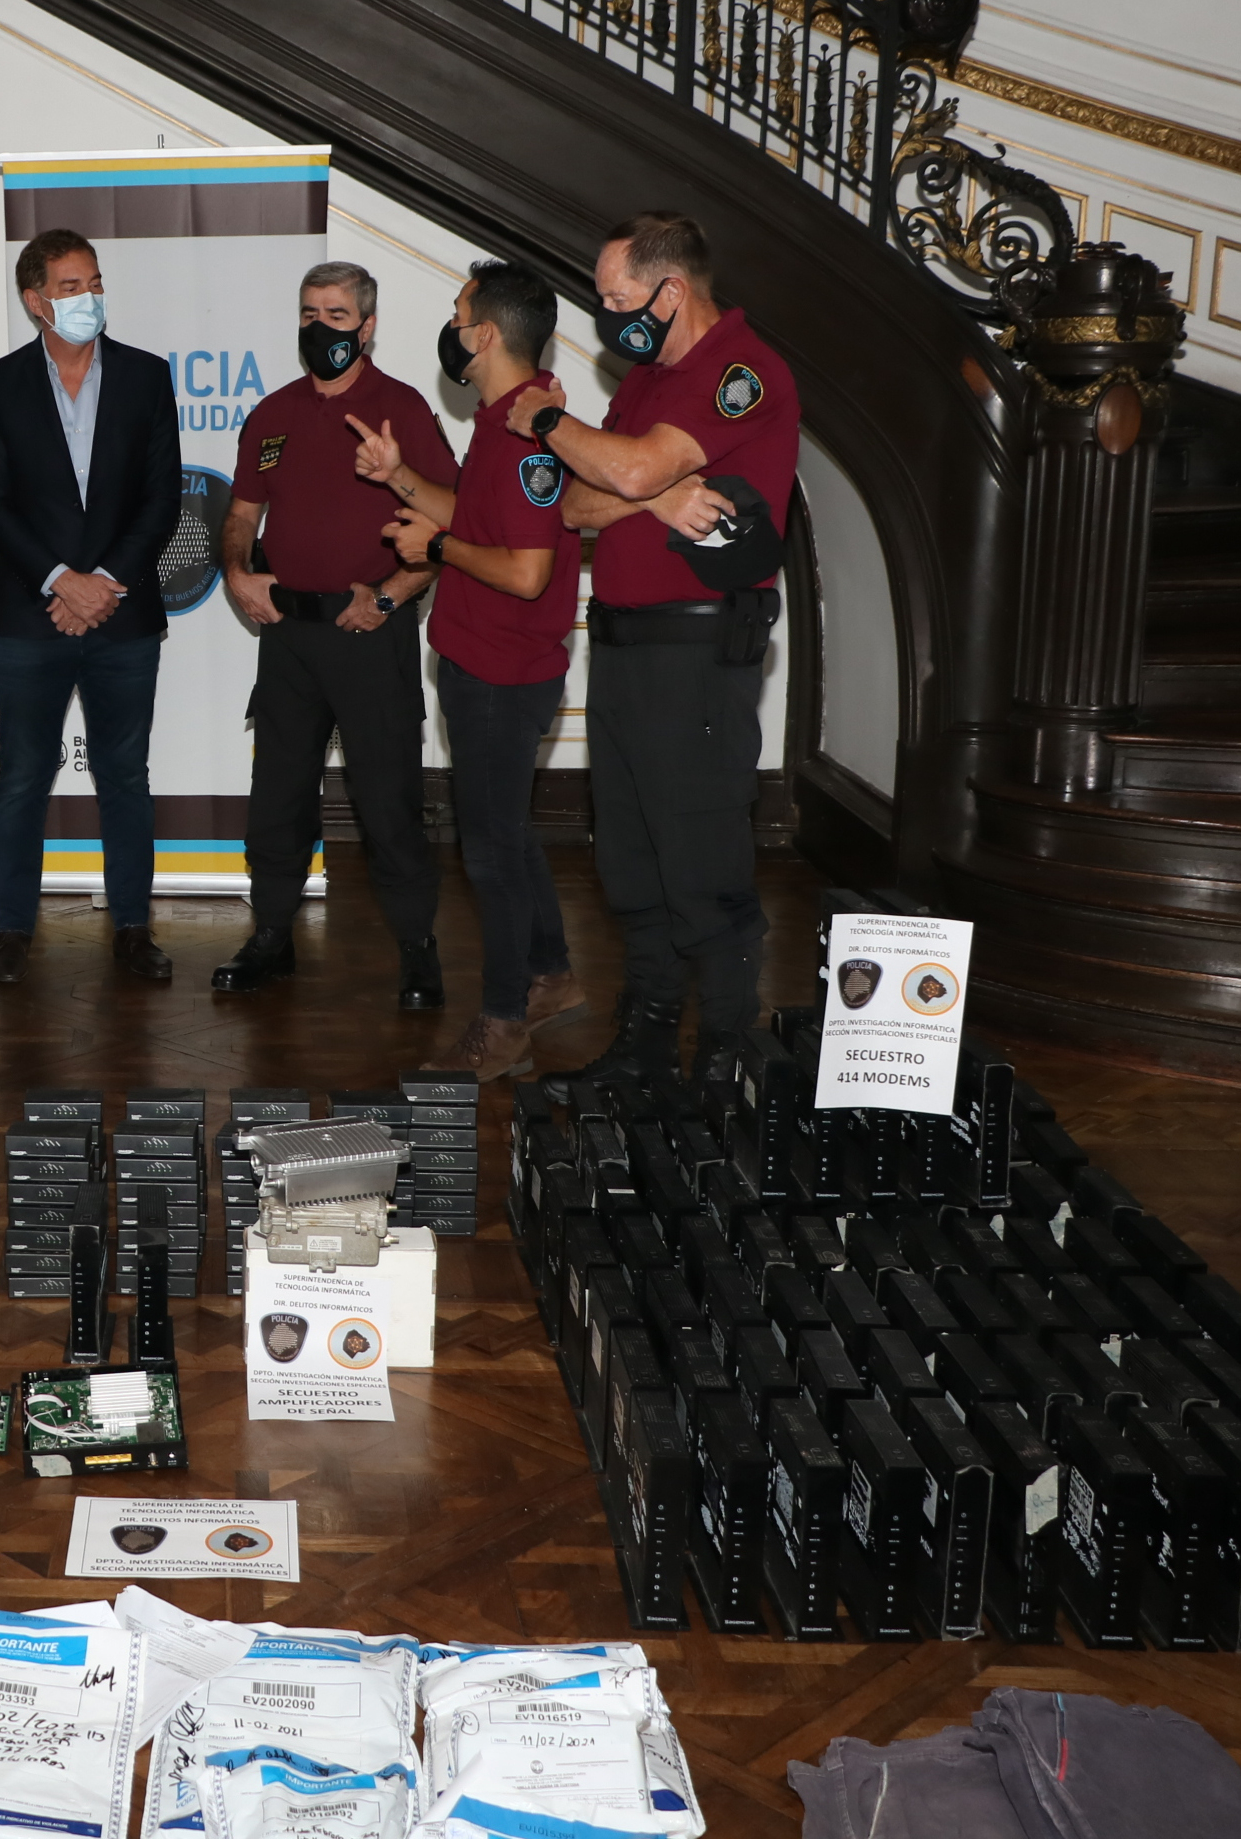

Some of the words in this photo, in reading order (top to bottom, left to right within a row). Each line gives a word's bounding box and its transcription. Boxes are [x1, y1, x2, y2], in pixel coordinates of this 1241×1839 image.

[179, 404, 258, 432] IUDA
[527, 457, 555, 467] POLICIA
[175, 582, 204, 602] BUENOS
[199, 565, 216, 590] AIRES
[857, 918, 929, 929] SUPERINTENDENCIA
[930, 922, 941, 930] DE
[850, 928, 894, 937] TECNOLOGÍA
[895, 930, 948, 940] INFORMÁTICA
[848, 945, 862, 953] DIR.
[863, 946, 892, 954] DELITOS
[893, 947, 950, 958] INFORMÁTICOS
[846, 961, 872, 970] POLICIA
[847, 1019, 901, 1028] INVESTIGACIÓN
[902, 1023, 955, 1033] INFORMÁTICA
[825, 1028, 851, 1037] SECCIÓN
[851, 1029, 914, 1039] INVESTIGACIONES
[915, 1033, 958, 1044] ESPECIALES
[845, 1049, 925, 1064] SECUESTRO
[837, 1072, 859, 1083] 414
[863, 1072, 930, 1088] MODEMS
[283, 1273, 353, 1286] SUPERINTENDENCIA
[275, 1282, 320, 1292] TECNOLOGÍA
[321, 1286, 371, 1297] INFORMÁTICA
[273, 1299, 288, 1307] DIR.
[289, 1301, 318, 1309] DELITOS
[319, 1303, 373, 1313] INFORMÁTICOS
[271, 1315, 299, 1325] POLICIA
[253, 1369, 275, 1377] DPTO.
[276, 1371, 331, 1380] INVESTIGACIÓN
[332, 1374, 382, 1382] INFORMÁTICA
[278, 1389, 359, 1397] SECUESTRO
[258, 1399, 382, 1407] AMPLIFICADORES
[90, 1564, 134, 1572] SECCIÓN
[230, 1568, 288, 1576] ESPECIALES
[129, 1559, 208, 1567] INVESTIGACIÓN
[210, 1560, 284, 1568] INFORMÁTICA
[243, 1695, 316, 1711] EV2002090
[515, 1712, 582, 1722] EV1016519
[284, 1773, 352, 1788] IMPORTANTE
